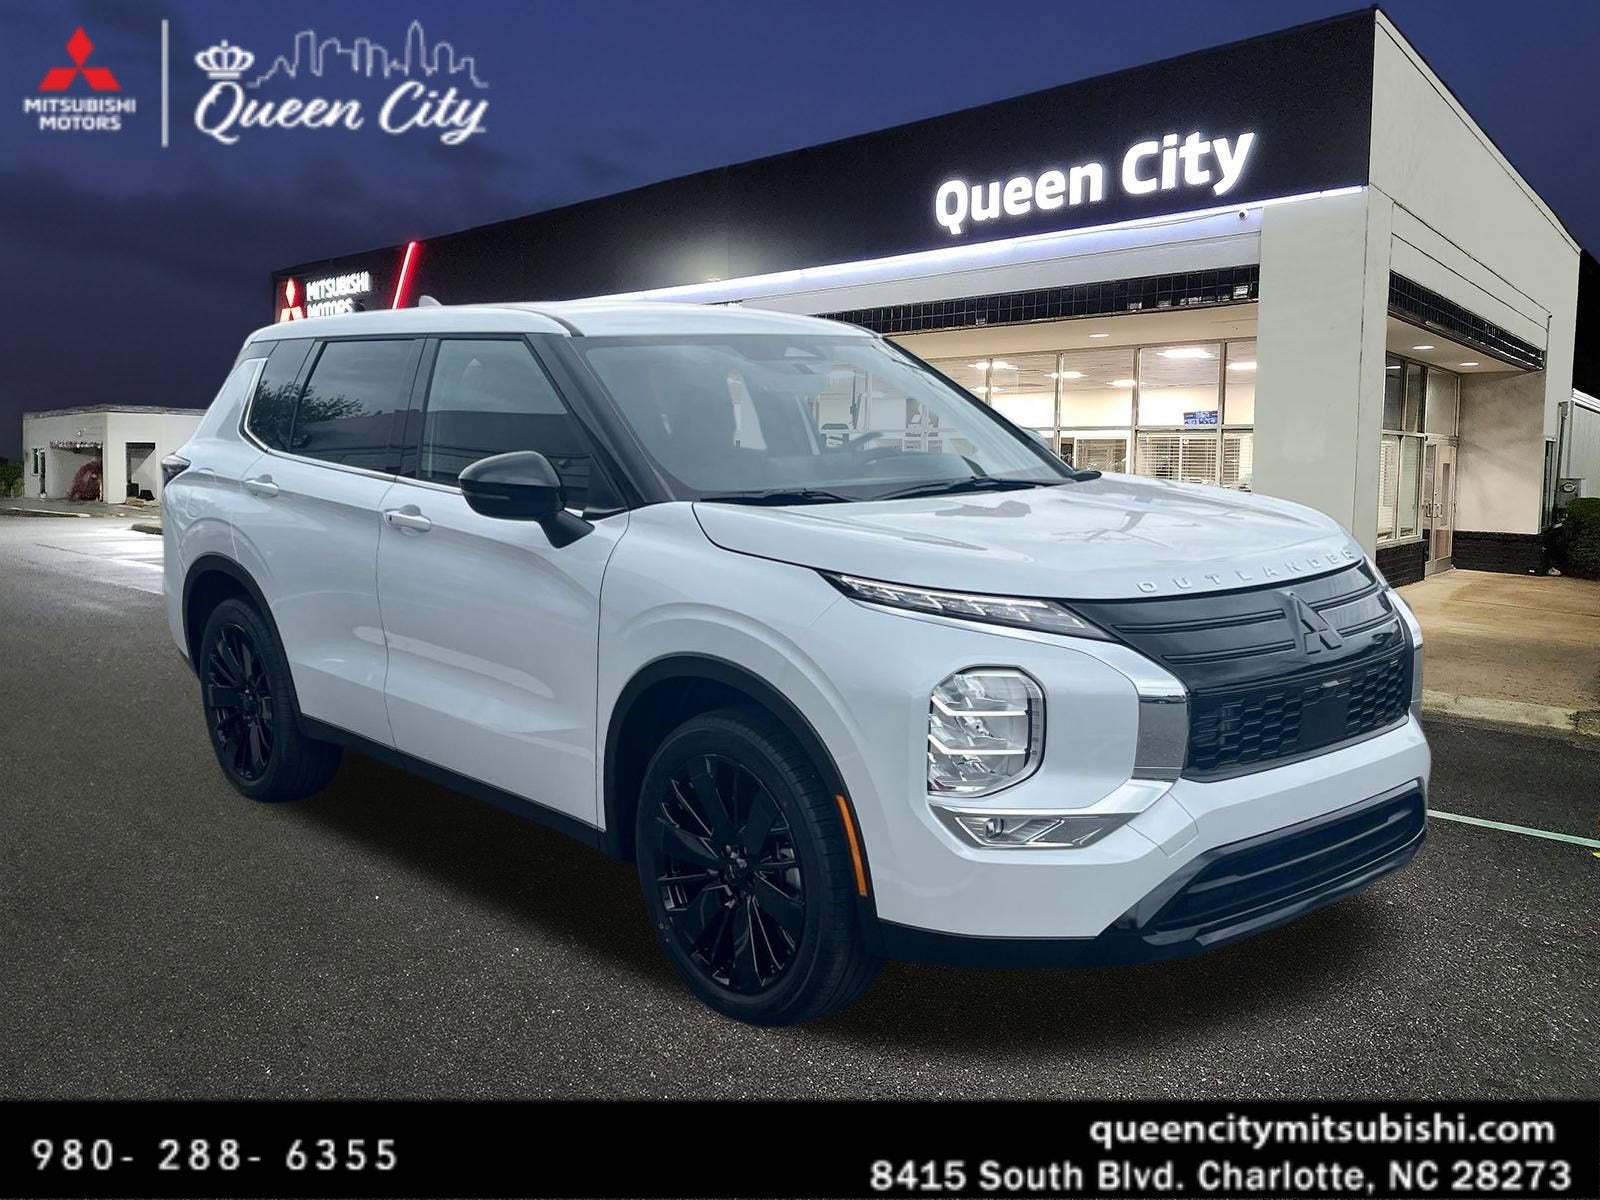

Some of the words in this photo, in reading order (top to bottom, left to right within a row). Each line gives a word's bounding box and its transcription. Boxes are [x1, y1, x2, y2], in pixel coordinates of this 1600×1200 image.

[935, 161, 1103, 235] Queen
[1122, 131, 1256, 196] City
[306, 271, 371, 301] MITSUBISHI
[1136, 547, 1355, 593] OUTLANDER
